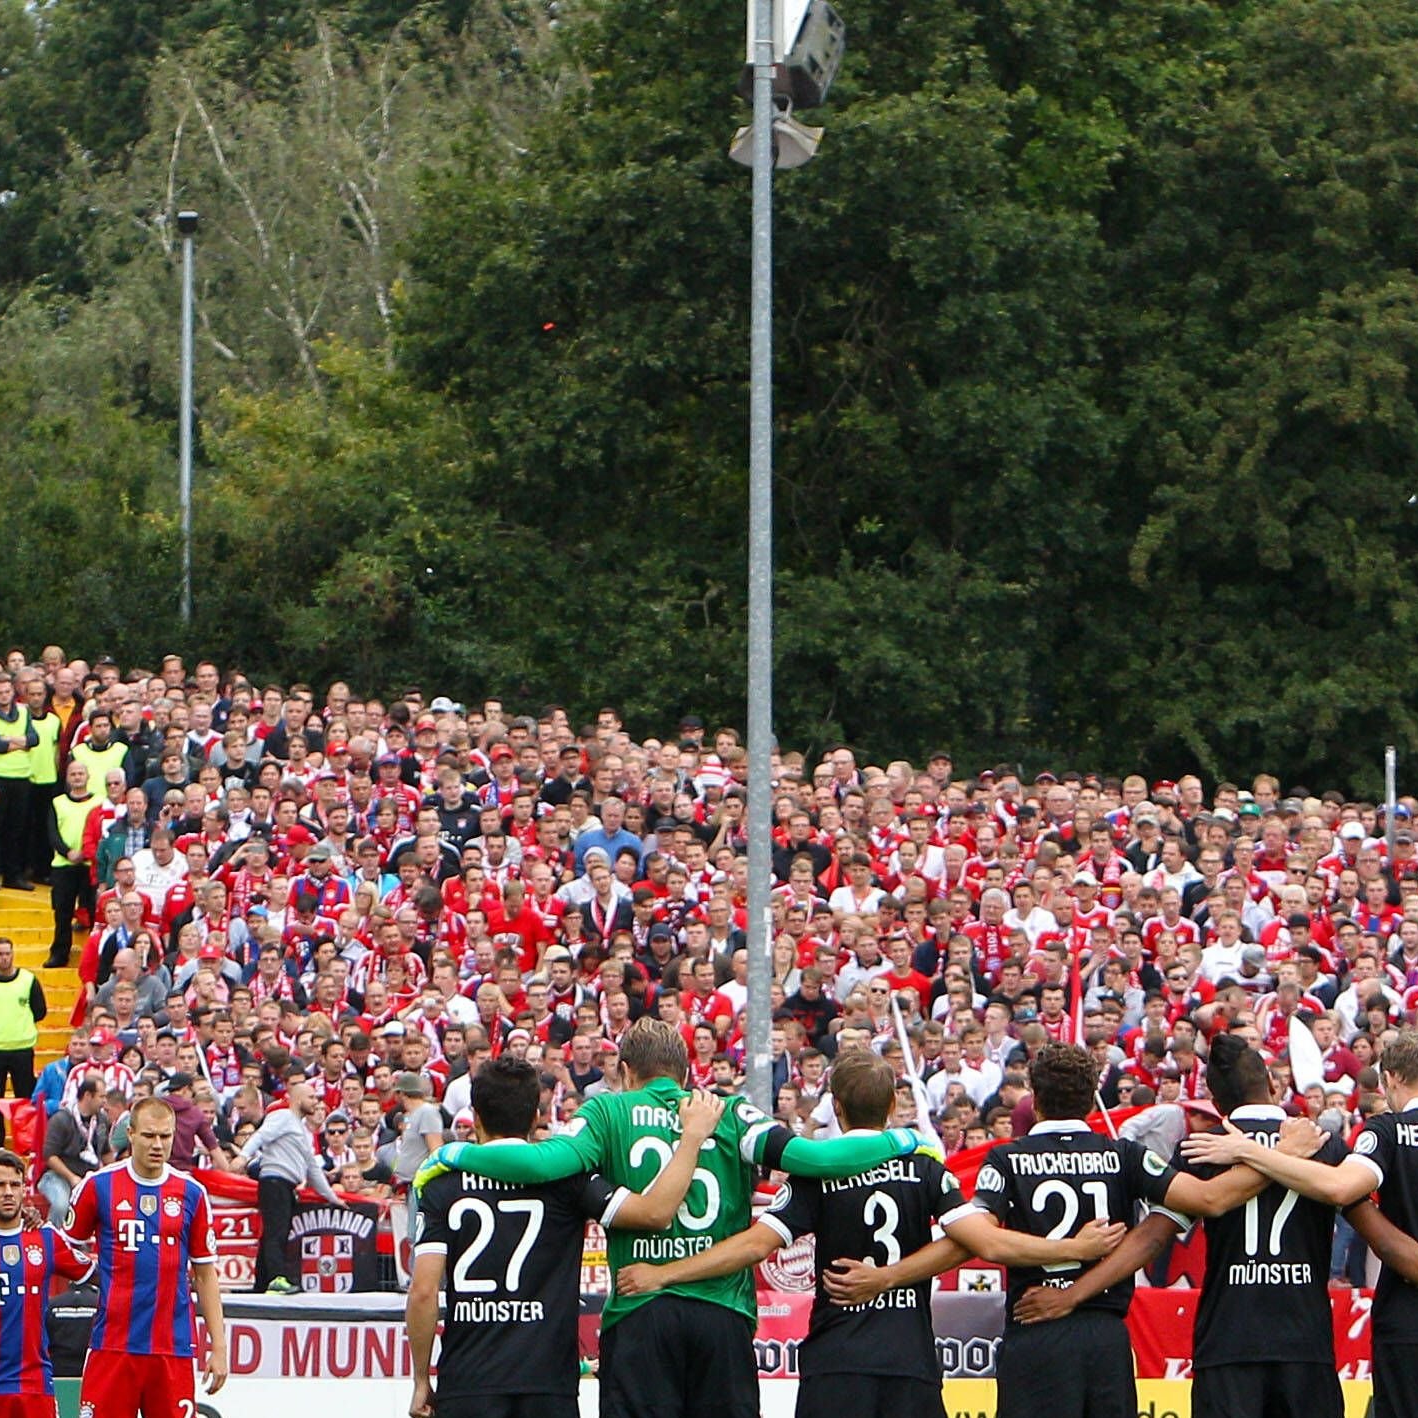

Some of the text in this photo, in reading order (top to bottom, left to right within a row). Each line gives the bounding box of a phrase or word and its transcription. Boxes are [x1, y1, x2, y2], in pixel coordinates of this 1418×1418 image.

[221, 1217, 254, 1237] 21
[288, 1208, 374, 1241] OMMANDO
[863, 1190, 901, 1269] 3
[1032, 1179, 1110, 1273] 21
[448, 1197, 544, 1293] 27
[1229, 1259, 1312, 1285] MÜNSTER
[454, 1298, 544, 1323] MÜNSTER
